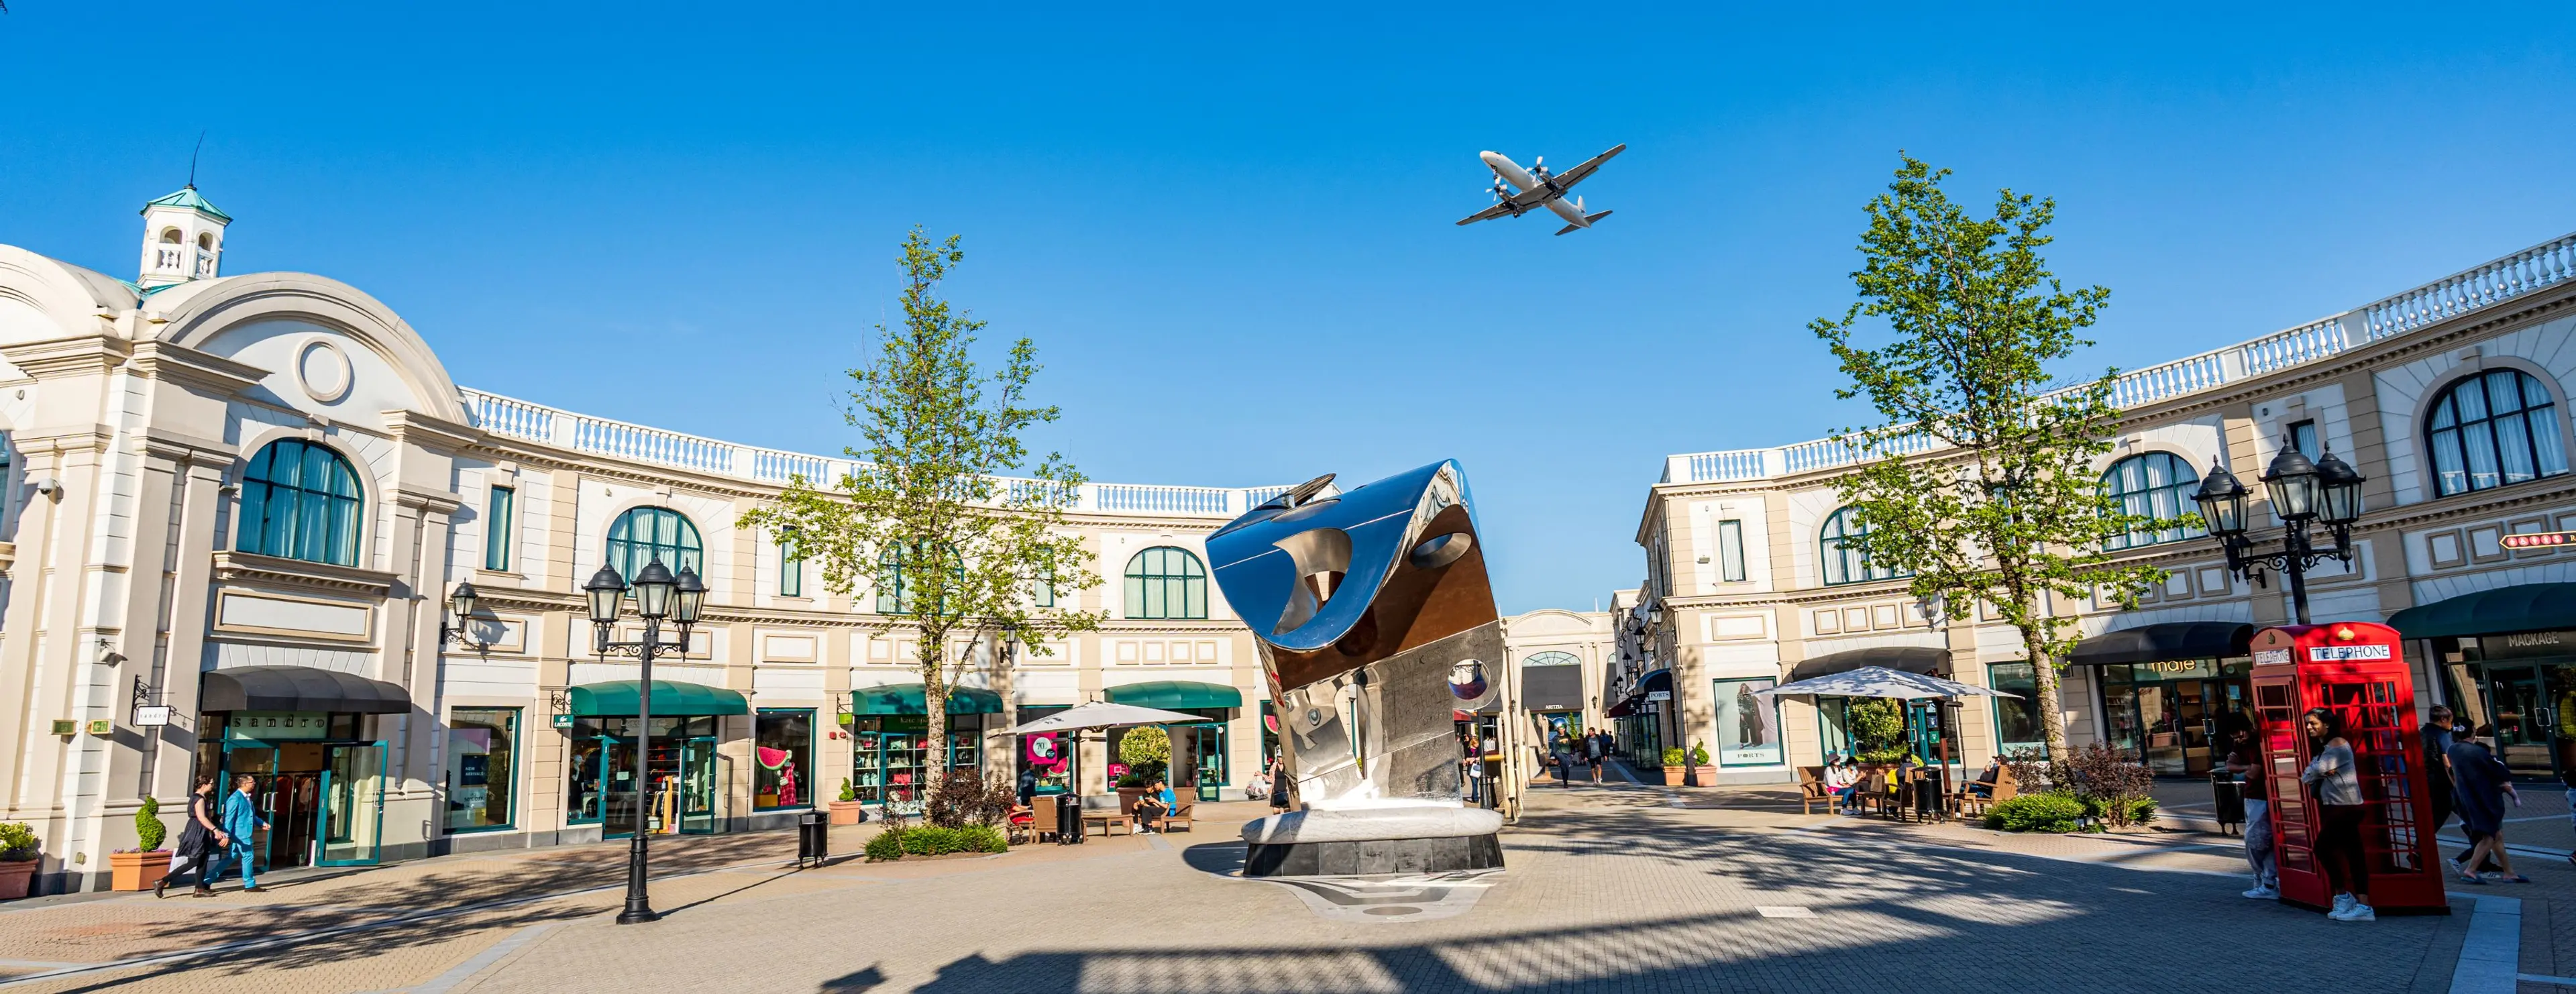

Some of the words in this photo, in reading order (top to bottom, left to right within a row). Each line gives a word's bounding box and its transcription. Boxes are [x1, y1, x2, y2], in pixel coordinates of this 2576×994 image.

[2508, 632, 2559, 647] MACKAGE
[2255, 650, 2289, 664] TELEPHONE
[2312, 645, 2389, 659] TELEPHONE
[2151, 660, 2194, 673] maje
[232, 714, 325, 728] sandro
